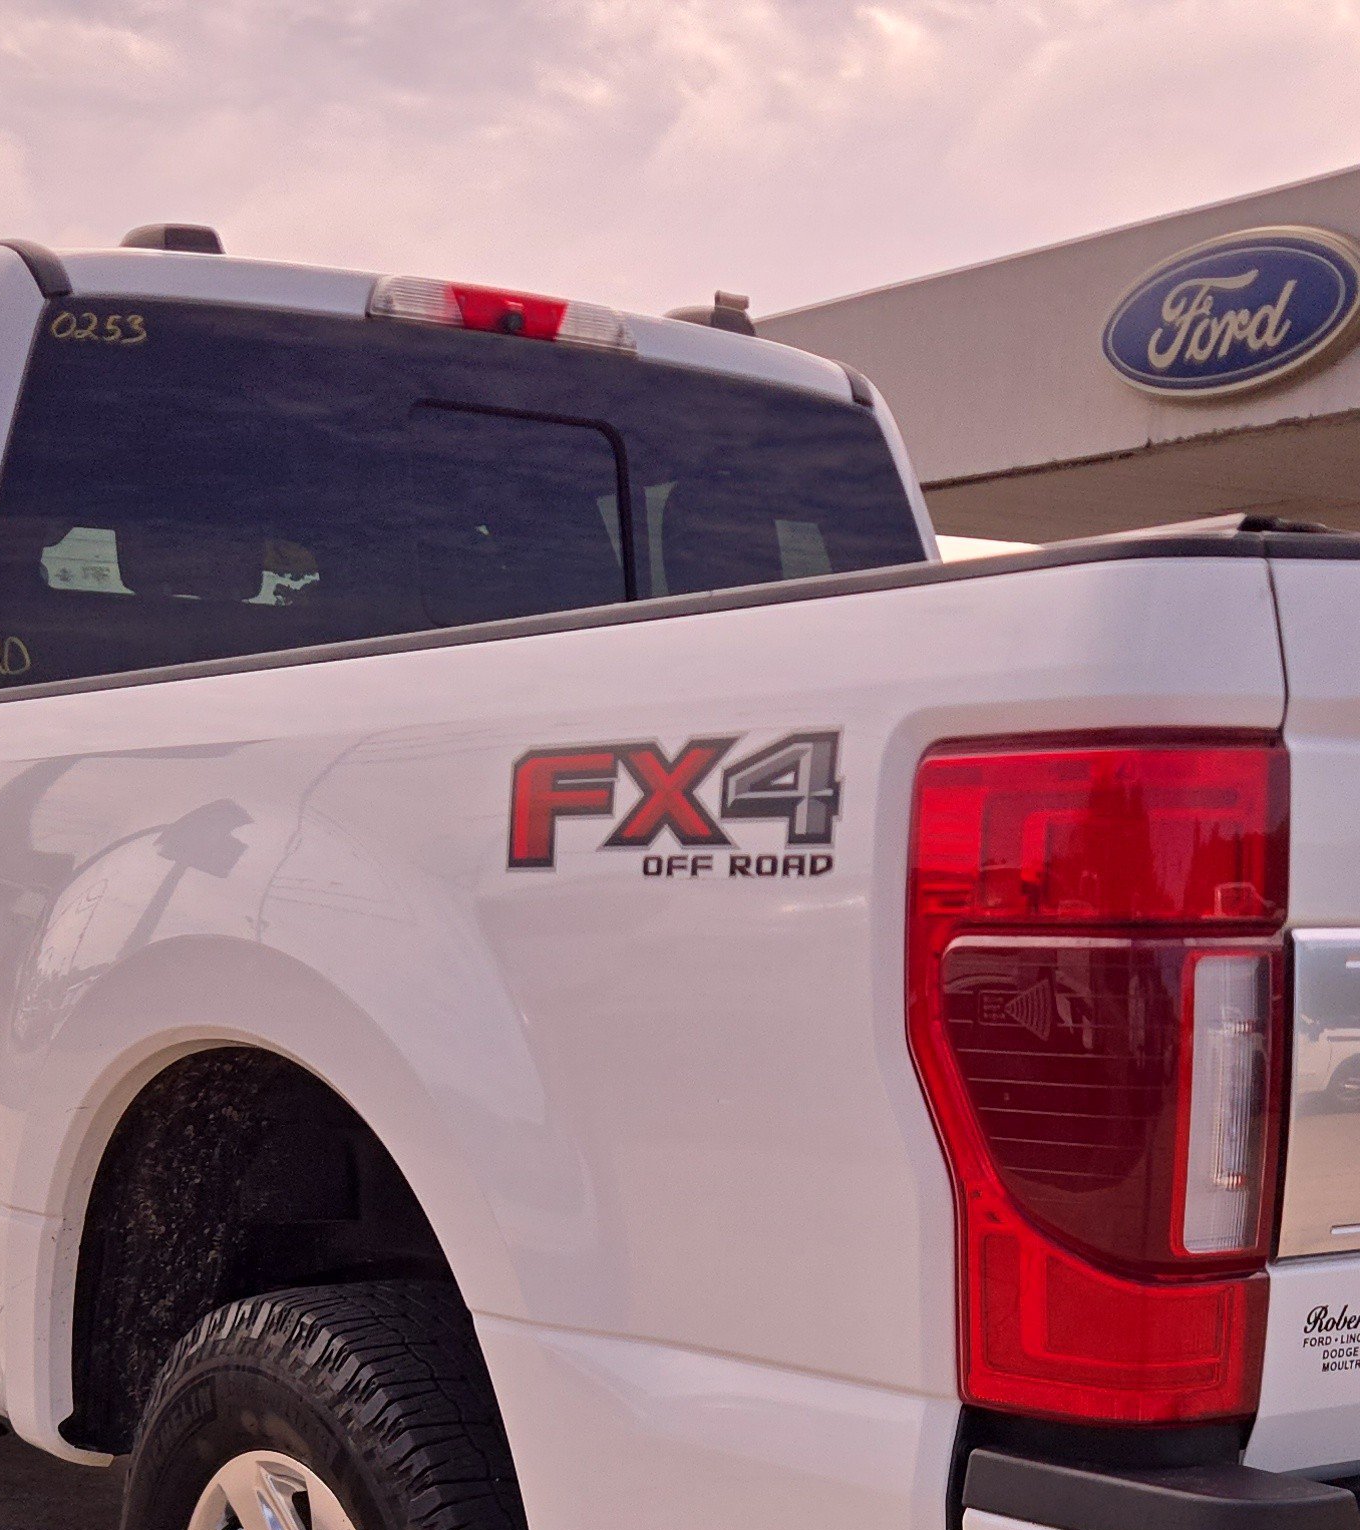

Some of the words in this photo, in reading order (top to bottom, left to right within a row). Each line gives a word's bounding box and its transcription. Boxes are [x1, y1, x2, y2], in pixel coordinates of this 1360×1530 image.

[51, 311, 147, 344] 0253
[1147, 269, 1297, 369] Ford
[506, 725, 842, 872] FX4
[642, 855, 714, 877] OFF
[729, 854, 834, 879] ROAD
[1302, 1336, 1332, 1348] FORD
[1322, 1347, 1359, 1360] DODGE
